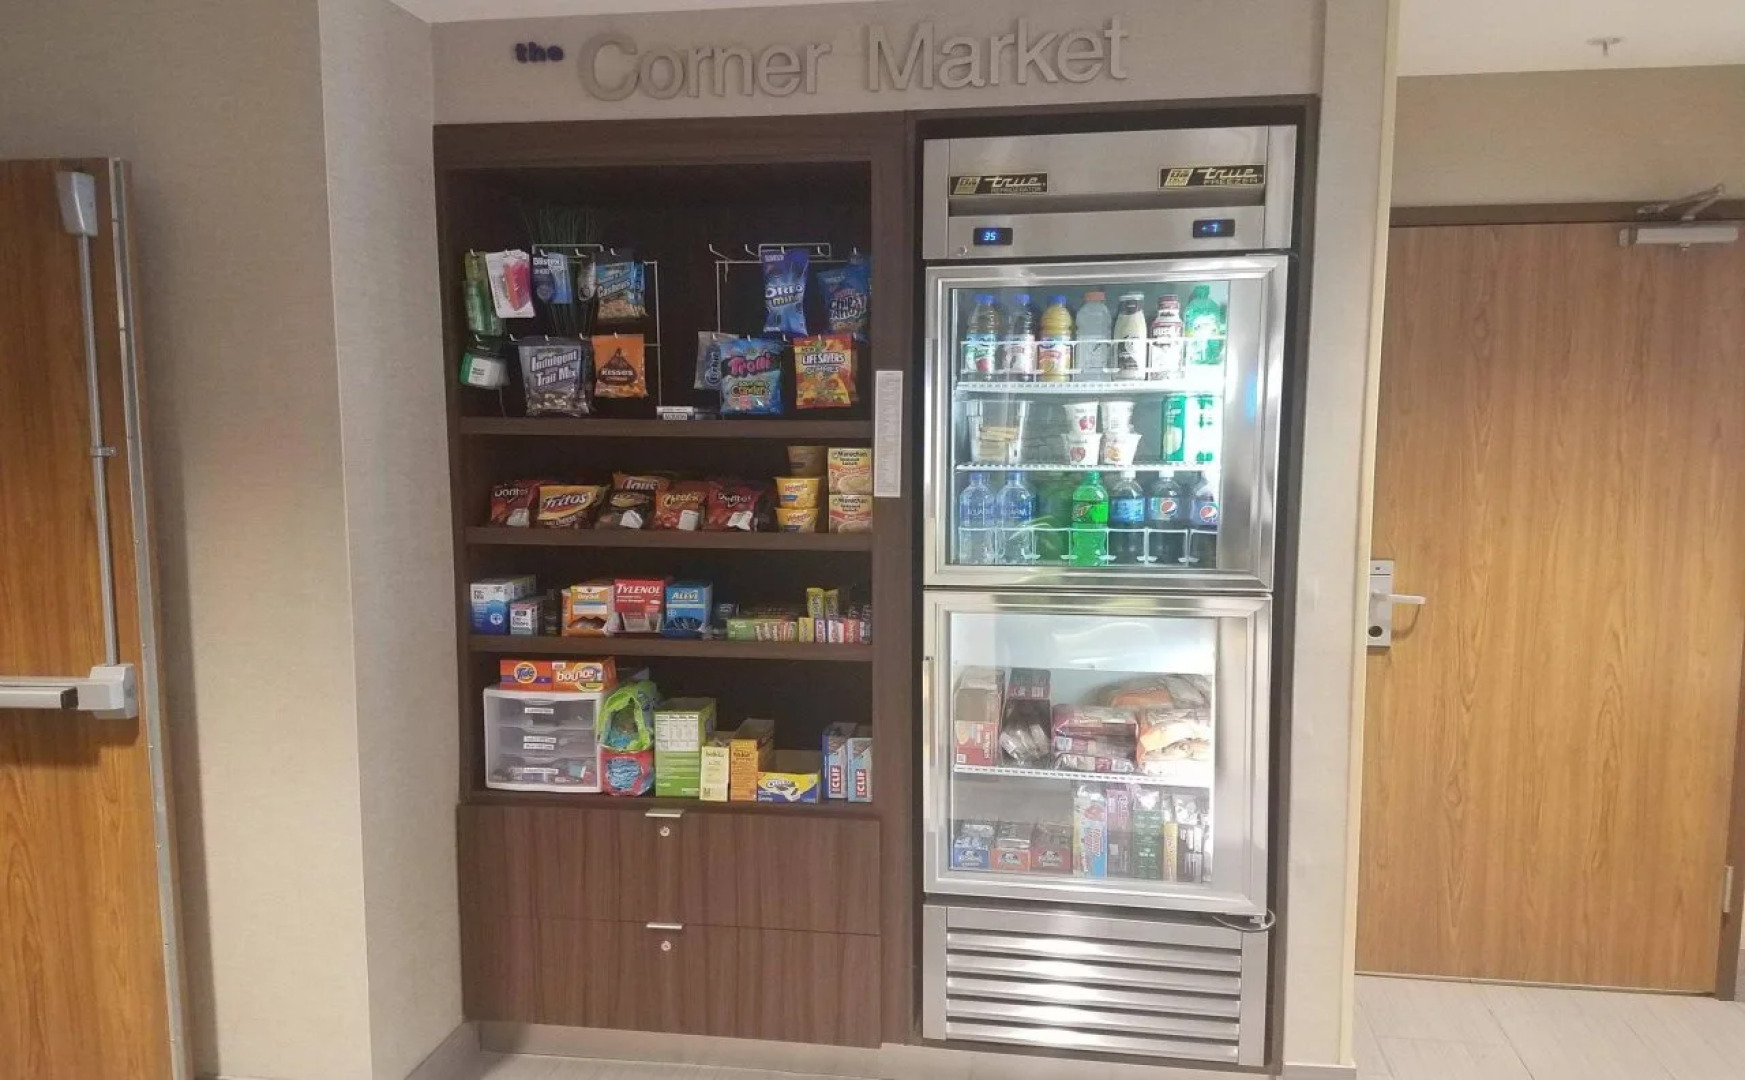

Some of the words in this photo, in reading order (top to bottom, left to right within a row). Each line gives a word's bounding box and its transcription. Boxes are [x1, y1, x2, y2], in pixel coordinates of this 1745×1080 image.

[514, 42, 564, 63] the
[576, 33, 833, 101] Corner
[866, 17, 1129, 91] Market
[984, 176, 1042, 188] true
[1197, 168, 1258, 180] true
[984, 231, 996, 241] 35
[531, 349, 578, 372] Indulgent
[536, 371, 557, 387] Trail
[558, 366, 577, 381] Mix
[543, 491, 587, 510] Fritos
[616, 583, 661, 594] TYLENOL
[831, 766, 841, 789] CLIF
[856, 770, 866, 792] CLIF
